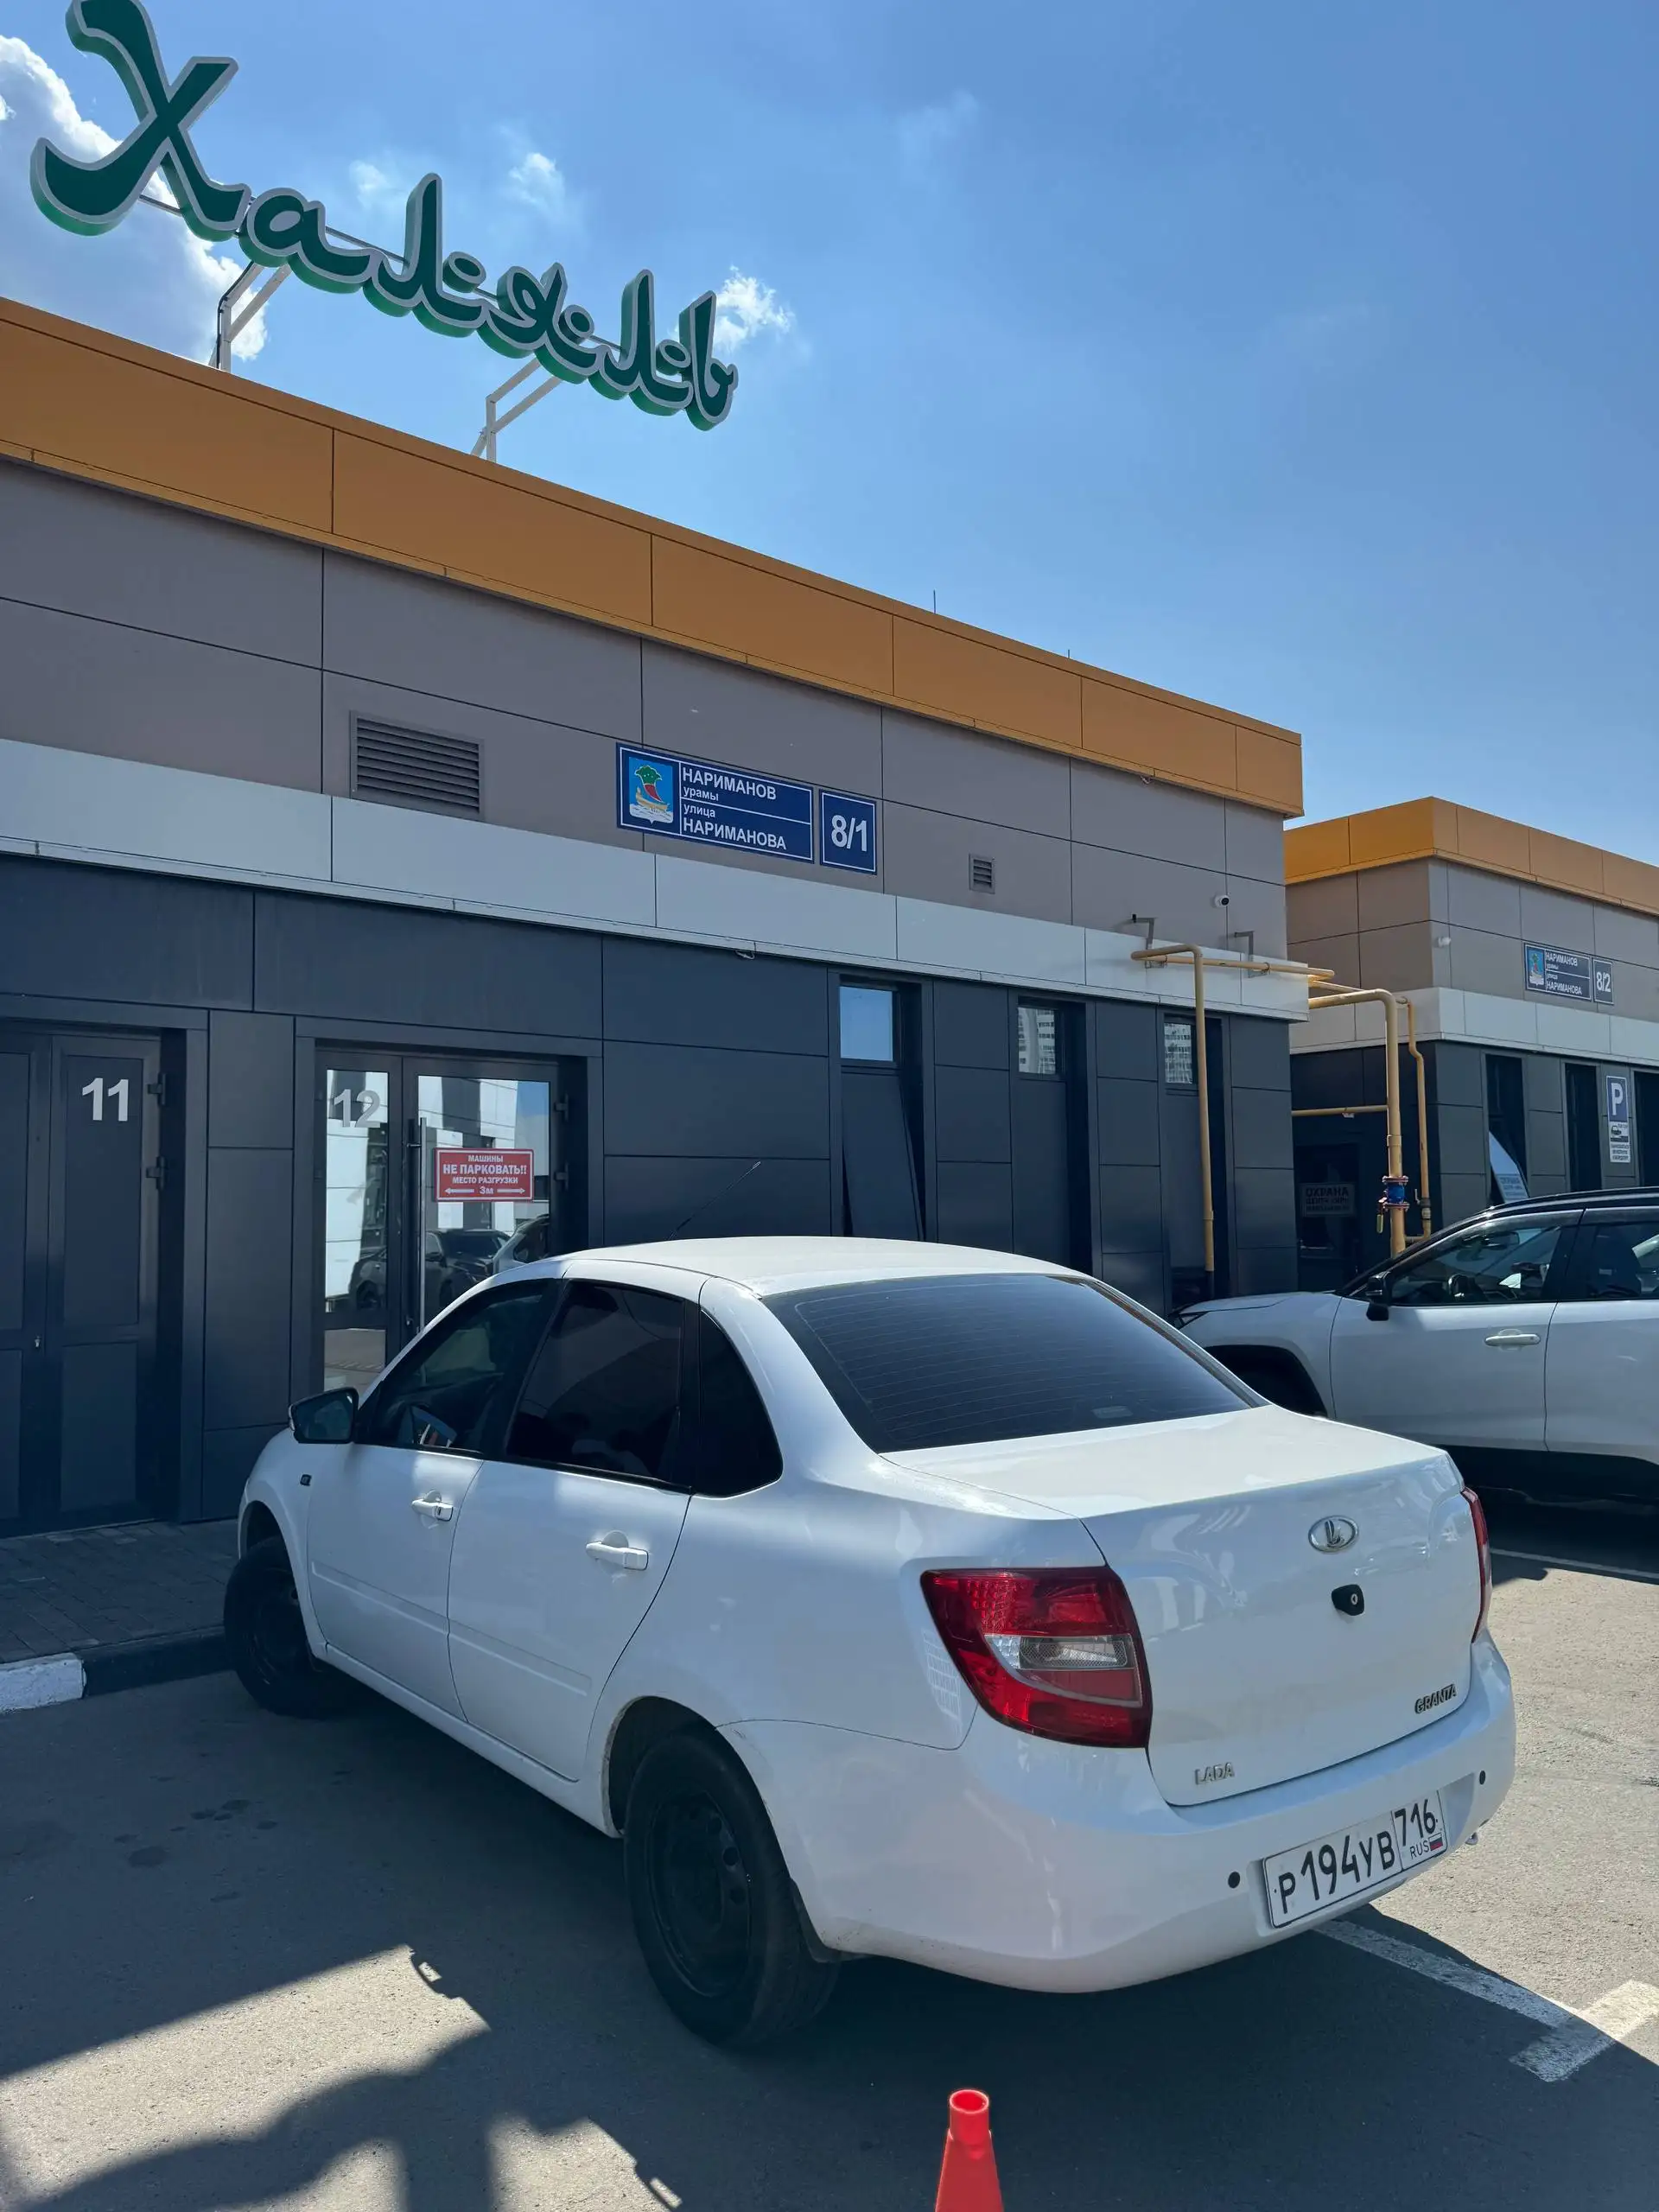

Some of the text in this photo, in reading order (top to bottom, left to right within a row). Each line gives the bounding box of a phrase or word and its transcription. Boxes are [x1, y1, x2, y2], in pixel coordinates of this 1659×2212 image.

[683, 767, 777, 800] НАРИМАНОВ
[683, 786, 719, 801] урамы
[683, 804, 715, 818] улица
[683, 818, 787, 850] НАРИМАНОВА
[831, 815, 868, 852] 8/1
[1546, 952, 1578, 967] НАРИМАНОВ
[1547, 982, 1582, 995] НАРИМАНОВА
[1596, 971, 1611, 993] 8/2
[82, 1077, 129, 1122] 11
[333, 1089, 380, 1128] 12
[1611, 1082, 1624, 1116] P
[442, 1164, 527, 1175] НЕ ПАРКОВАТЬ!!
[1414, 1683, 1457, 1714] GRANTA
[1194, 1762, 1236, 1785] LADA
[1394, 1798, 1436, 1847] 716
[1409, 1841, 1430, 1859] RUS
